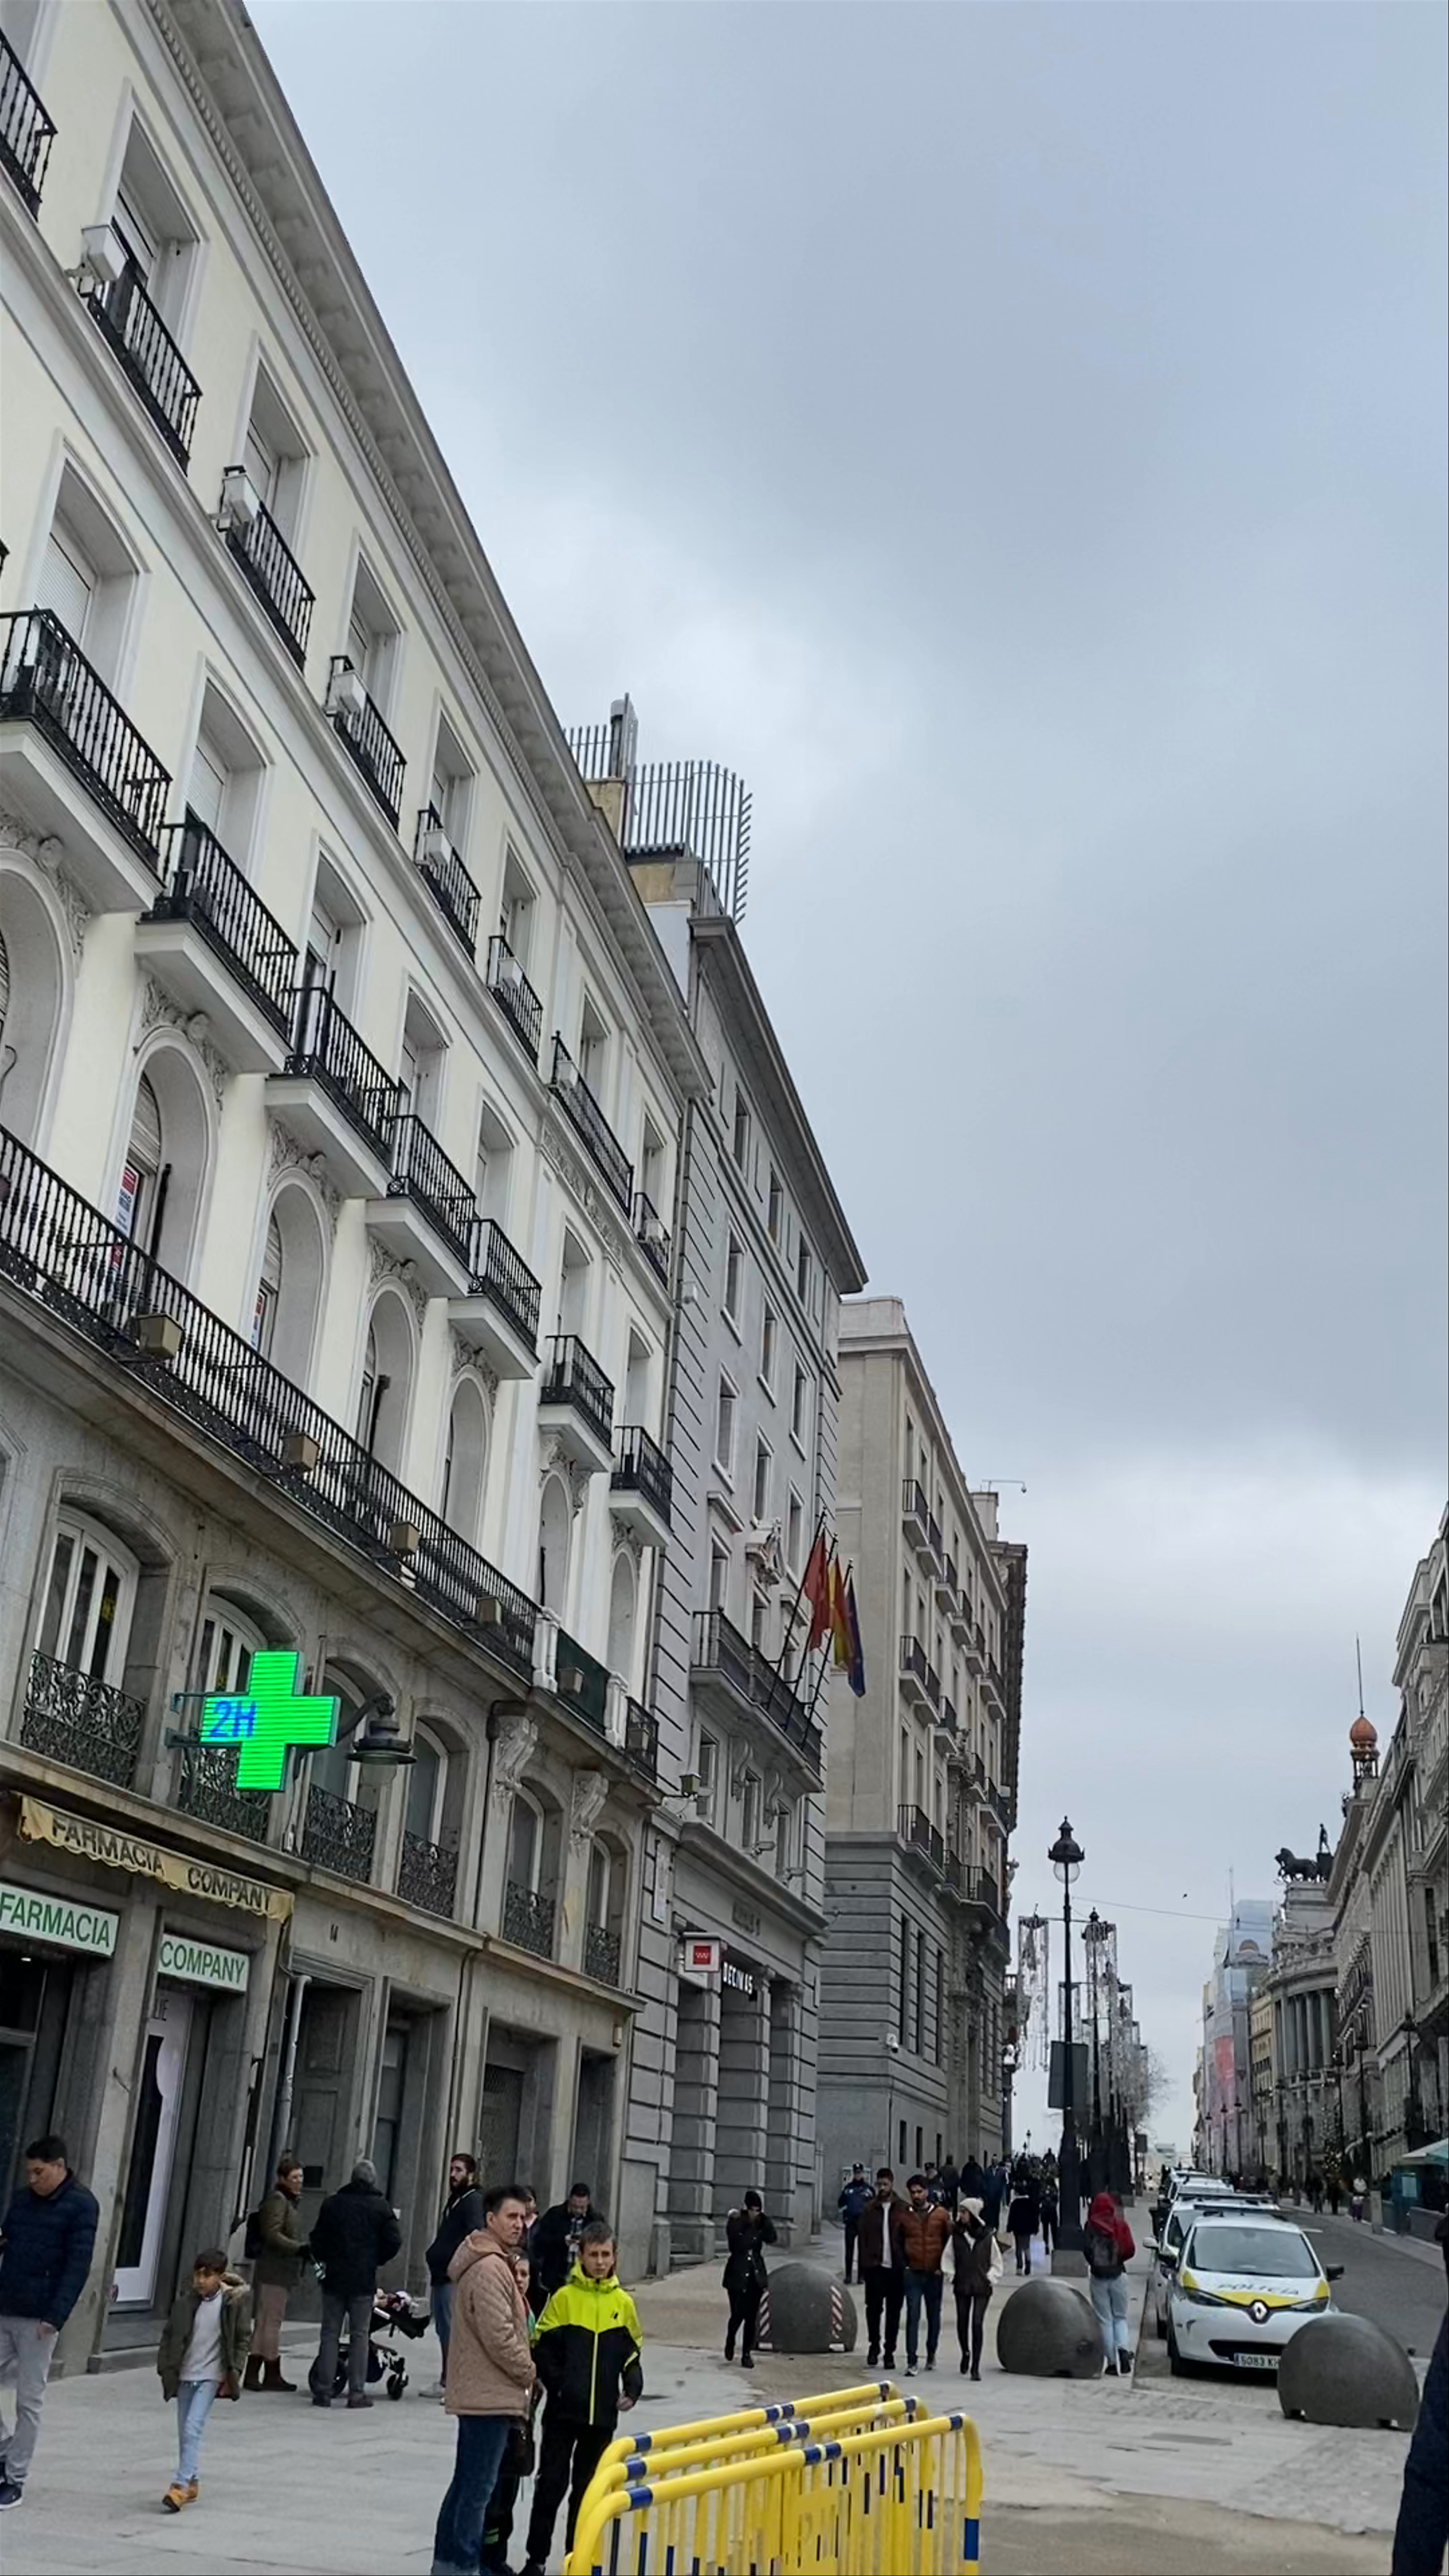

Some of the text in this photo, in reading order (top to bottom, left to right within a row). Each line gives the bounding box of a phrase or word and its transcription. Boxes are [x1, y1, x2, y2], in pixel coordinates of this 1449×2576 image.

[209, 1701, 255, 1738] 2H
[53, 1819, 269, 1911] FARMACIA COMPANY
[0, 1892, 109, 1947] FARMACIA
[160, 1941, 245, 1984] COMPANY
